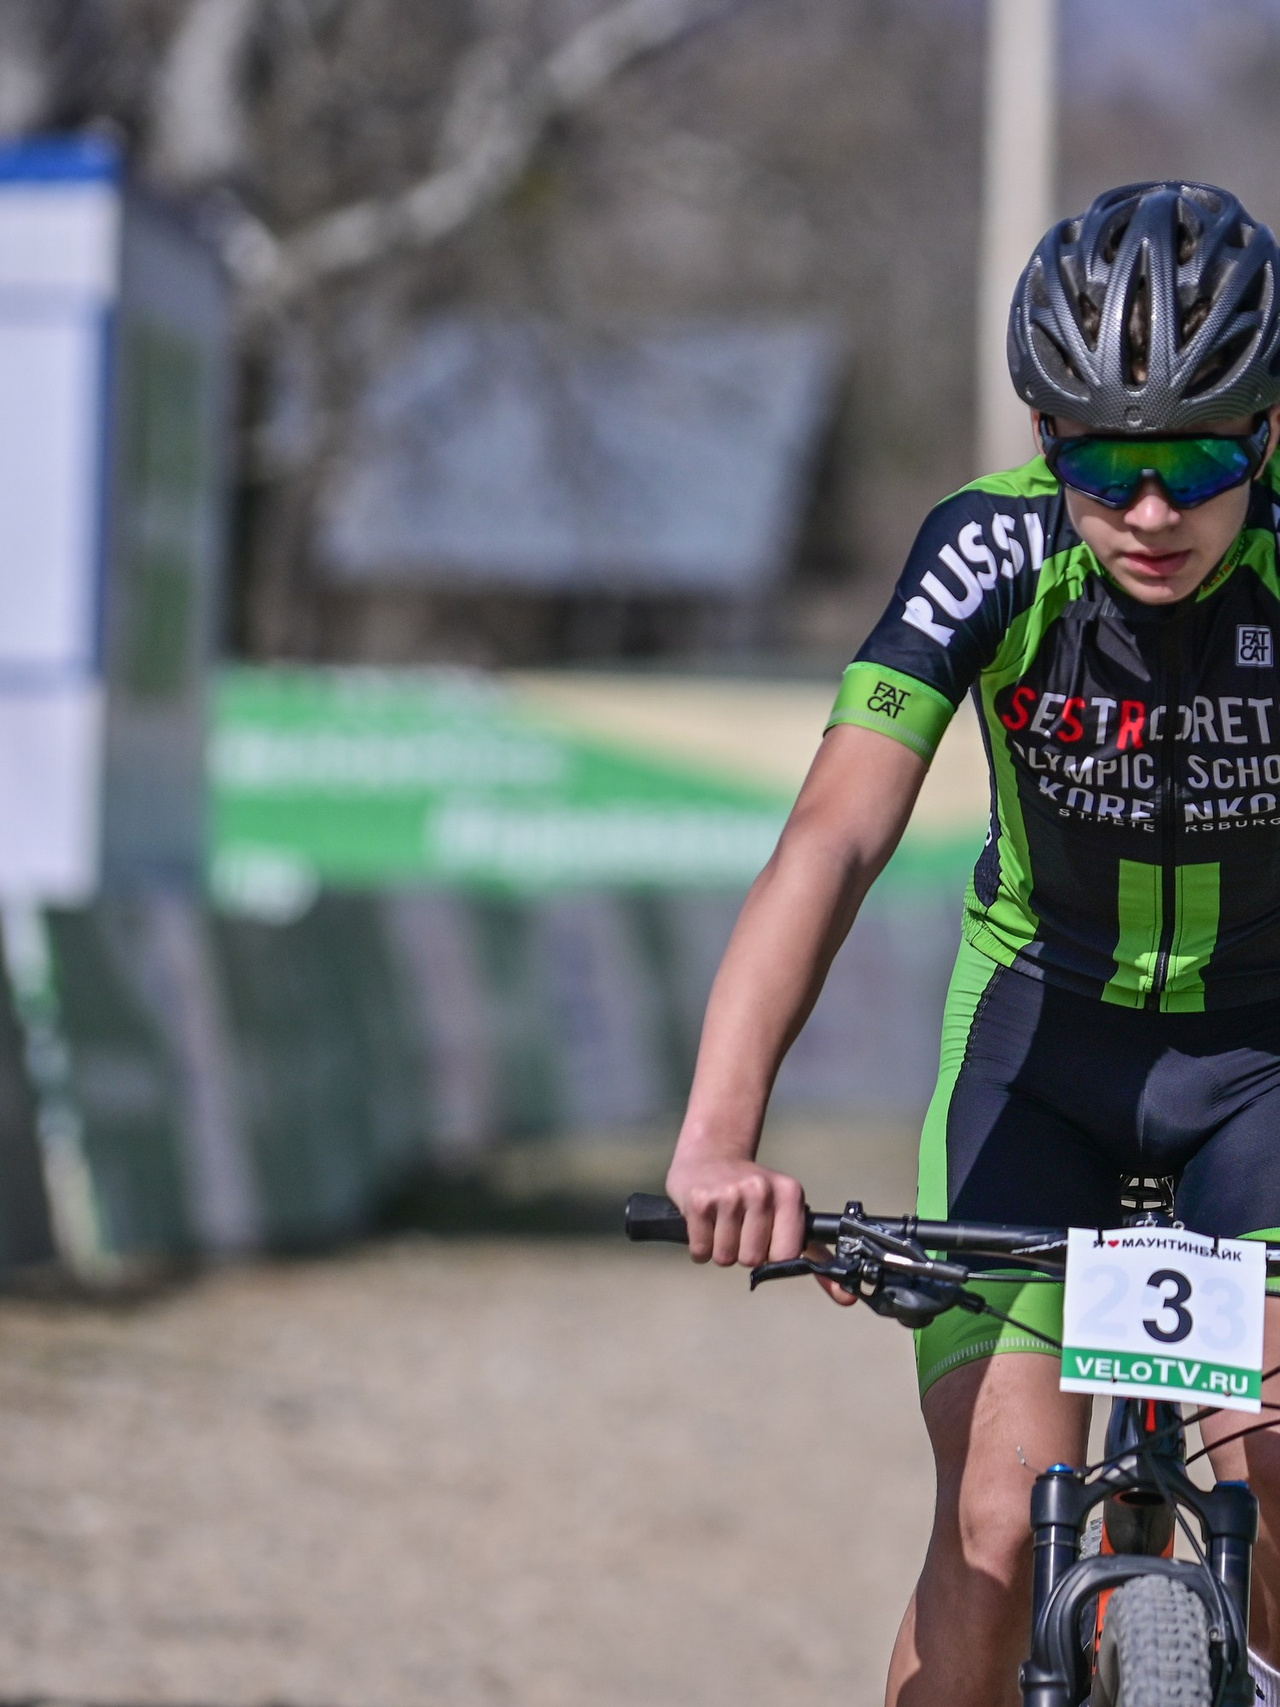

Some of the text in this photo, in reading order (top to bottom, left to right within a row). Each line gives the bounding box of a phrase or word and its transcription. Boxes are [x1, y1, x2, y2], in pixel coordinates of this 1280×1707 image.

[901, 512, 1044, 647] RUSSI
[1241, 630, 1270, 646] FAT
[1239, 645, 1270, 662] CAT
[873, 680, 911, 705] FAT
[867, 696, 905, 719] CAT
[1142, 1267, 1193, 1345] 3
[1075, 1355, 1249, 1394] VELOTV.RU
